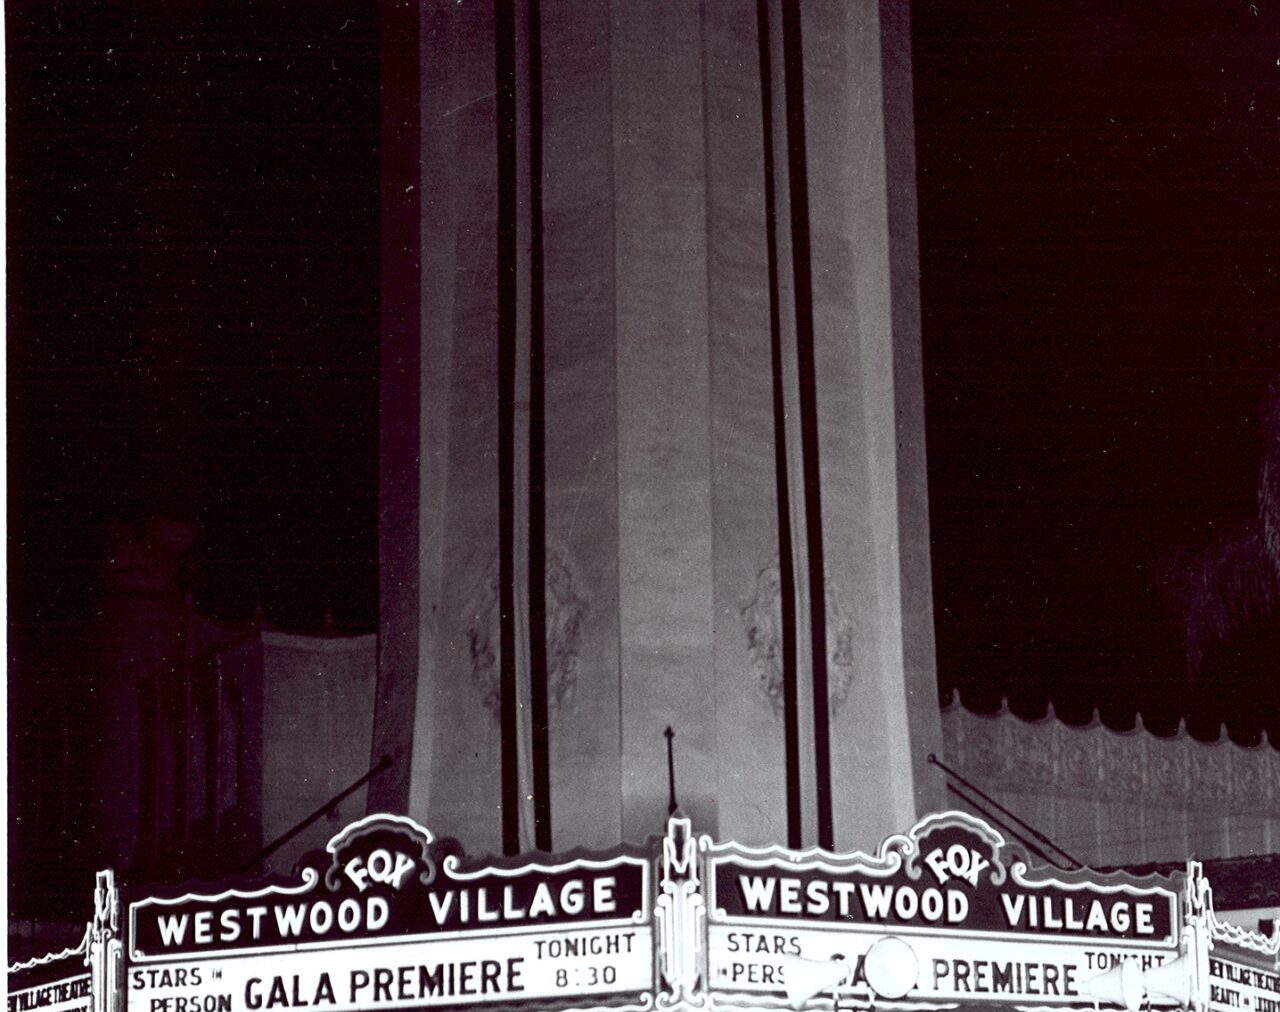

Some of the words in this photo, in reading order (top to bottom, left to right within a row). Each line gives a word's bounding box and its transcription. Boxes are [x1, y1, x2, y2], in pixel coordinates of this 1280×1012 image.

[344, 849, 416, 892] FOX
[924, 844, 990, 888] FOX
[157, 897, 389, 946] WESTWOOD
[428, 876, 616, 925] VILLAGE
[739, 875, 969, 922] WESTWOOD
[1001, 893, 1155, 934] VILLAGE
[533, 932, 636, 960] TONIGHT
[727, 933, 802, 956] STARS
[1084, 951, 1166, 973] TONHT
[132, 967, 202, 990] STARS
[244, 971, 337, 1010] GALA
[349, 957, 525, 1003] PREMIERE
[555, 965, 617, 988] 8:30
[732, 962, 785, 985] PERS
[932, 958, 1079, 996] PREMIERE
[19, 986, 53, 1012] VILLAGE
[53, 976, 92, 1004] THEATRE
